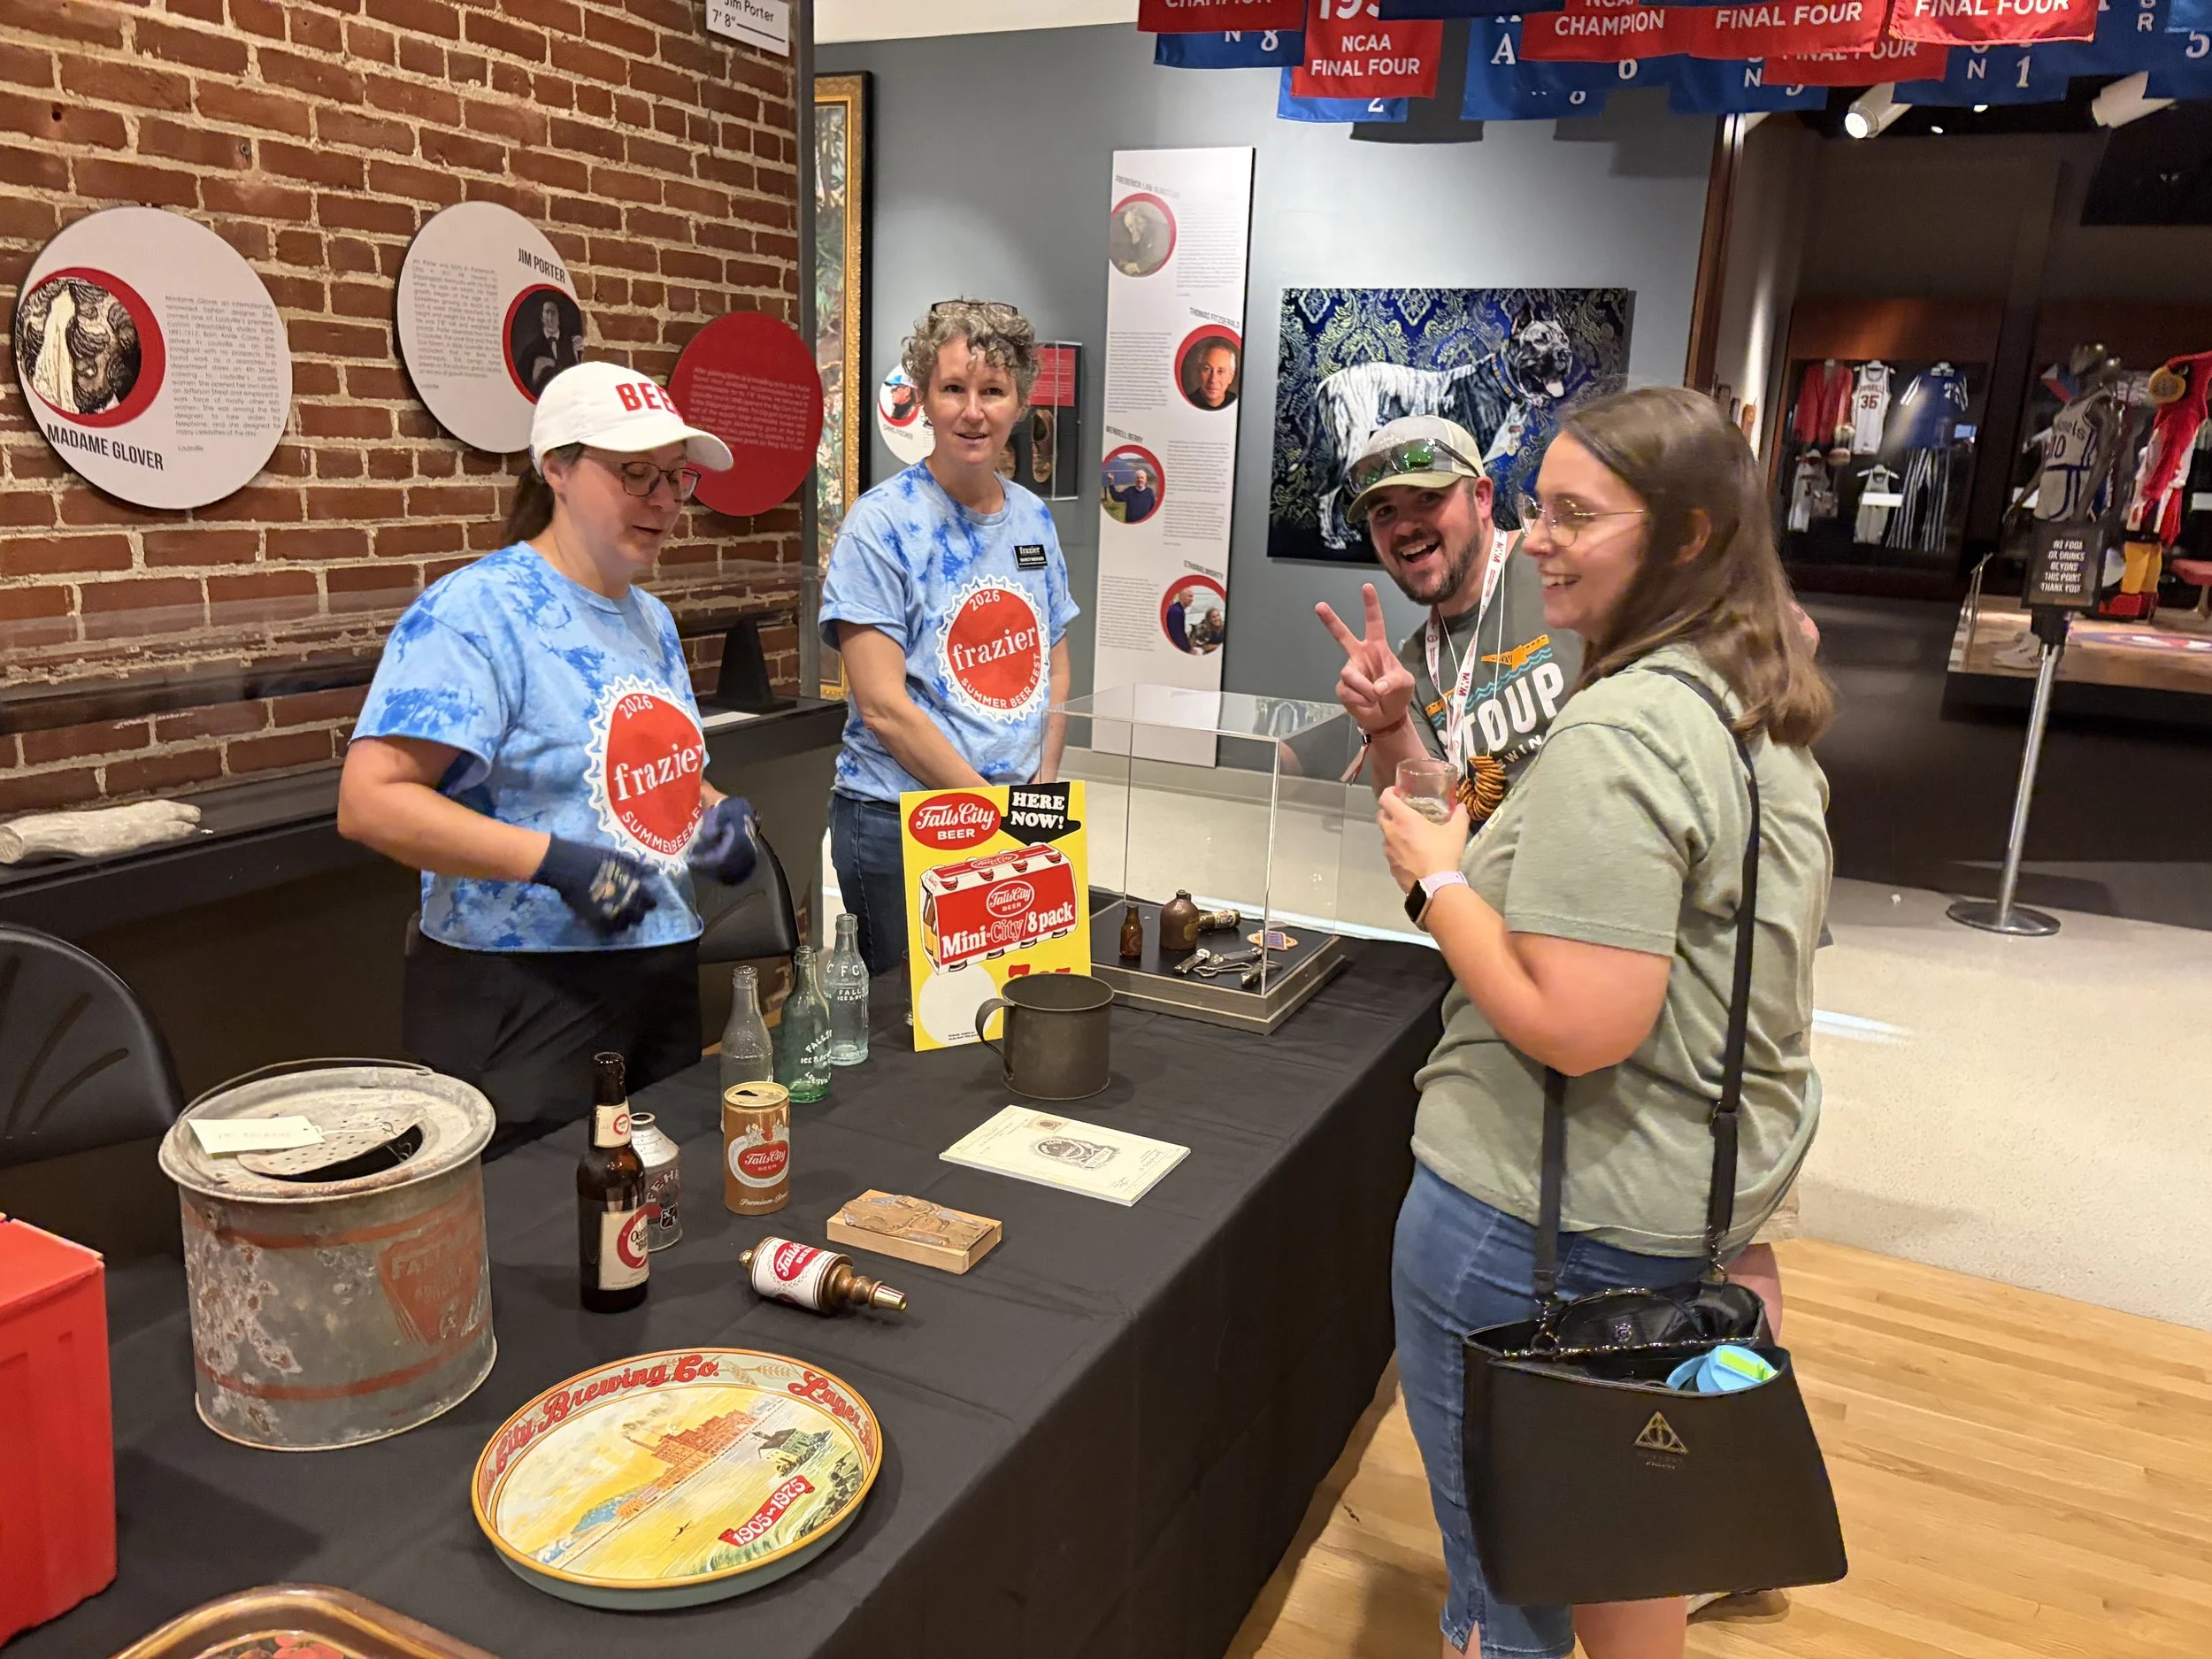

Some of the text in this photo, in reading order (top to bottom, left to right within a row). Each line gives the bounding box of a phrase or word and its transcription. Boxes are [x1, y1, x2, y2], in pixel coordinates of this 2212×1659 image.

[744, 1, 774, 22] Porter
[1716, 3, 1863, 29] FINAL FOUR
[1915, 0, 1990, 17] FINAL
[1555, 9, 1666, 36] CHAMPION
[1341, 34, 1392, 53] NCAA
[1491, 33, 1517, 65] A
[1311, 58, 1421, 77] FINAL FOUR
[1744, 68, 1763, 88] N
[518, 248, 565, 283] JIM PORTER
[616, 382, 685, 424] BEE
[46, 423, 165, 471] MADAME GLOVER
[969, 590, 1001, 611] 2026
[952, 626, 1036, 672] frazier
[1029, 653, 1041, 686] FEST
[961, 678, 1033, 709] SUMMER BEER
[619, 695, 653, 718] 2026
[1011, 791, 1066, 811] HERE
[915, 802, 995, 830] Falls City
[1010, 810, 1064, 831] NOW!
[671, 821, 694, 853] BEER
[937, 828, 976, 841] BEER
[989, 887, 1031, 908] Falls City
[1002, 902, 1022, 912] BEER
[744, 1153, 770, 1165] Falls
[539, 1355, 861, 1432] Brewing Co. Lager
